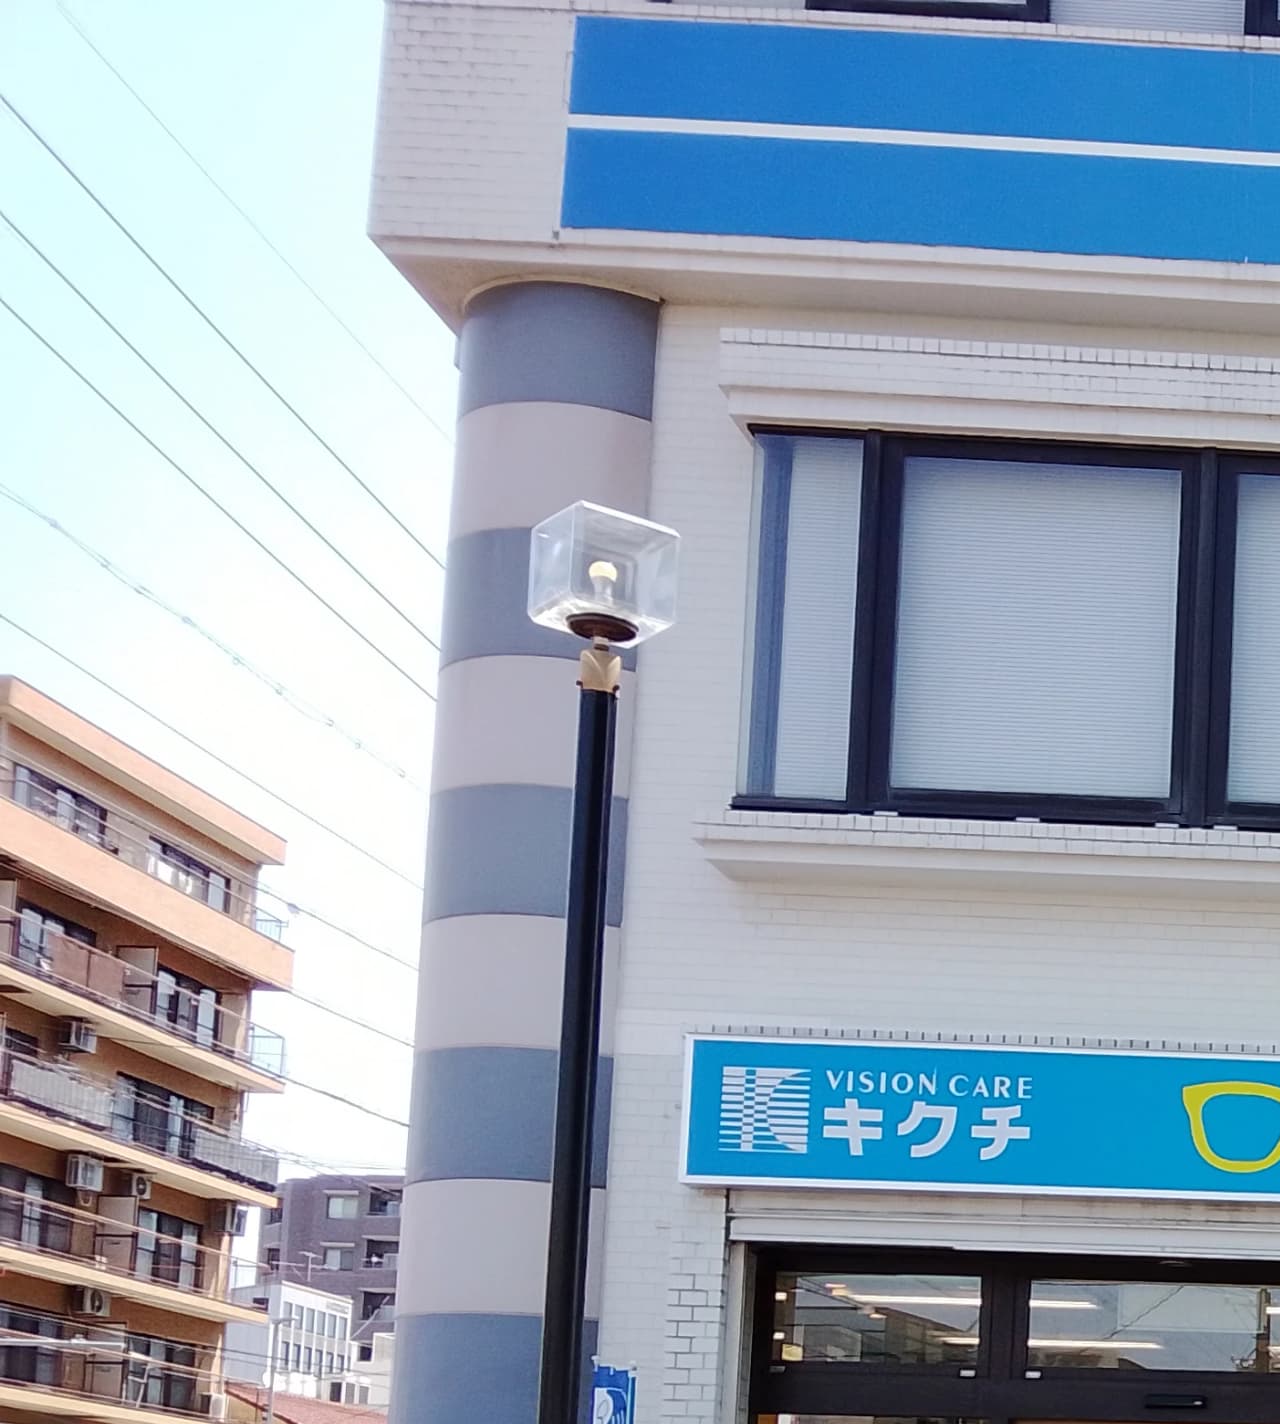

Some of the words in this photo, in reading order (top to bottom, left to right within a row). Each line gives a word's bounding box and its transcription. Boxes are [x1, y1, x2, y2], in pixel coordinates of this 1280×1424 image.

[826, 1069, 937, 1095] VISION
[949, 1075, 1033, 1099] CARE
[823, 1098, 1030, 1160] キクチ
